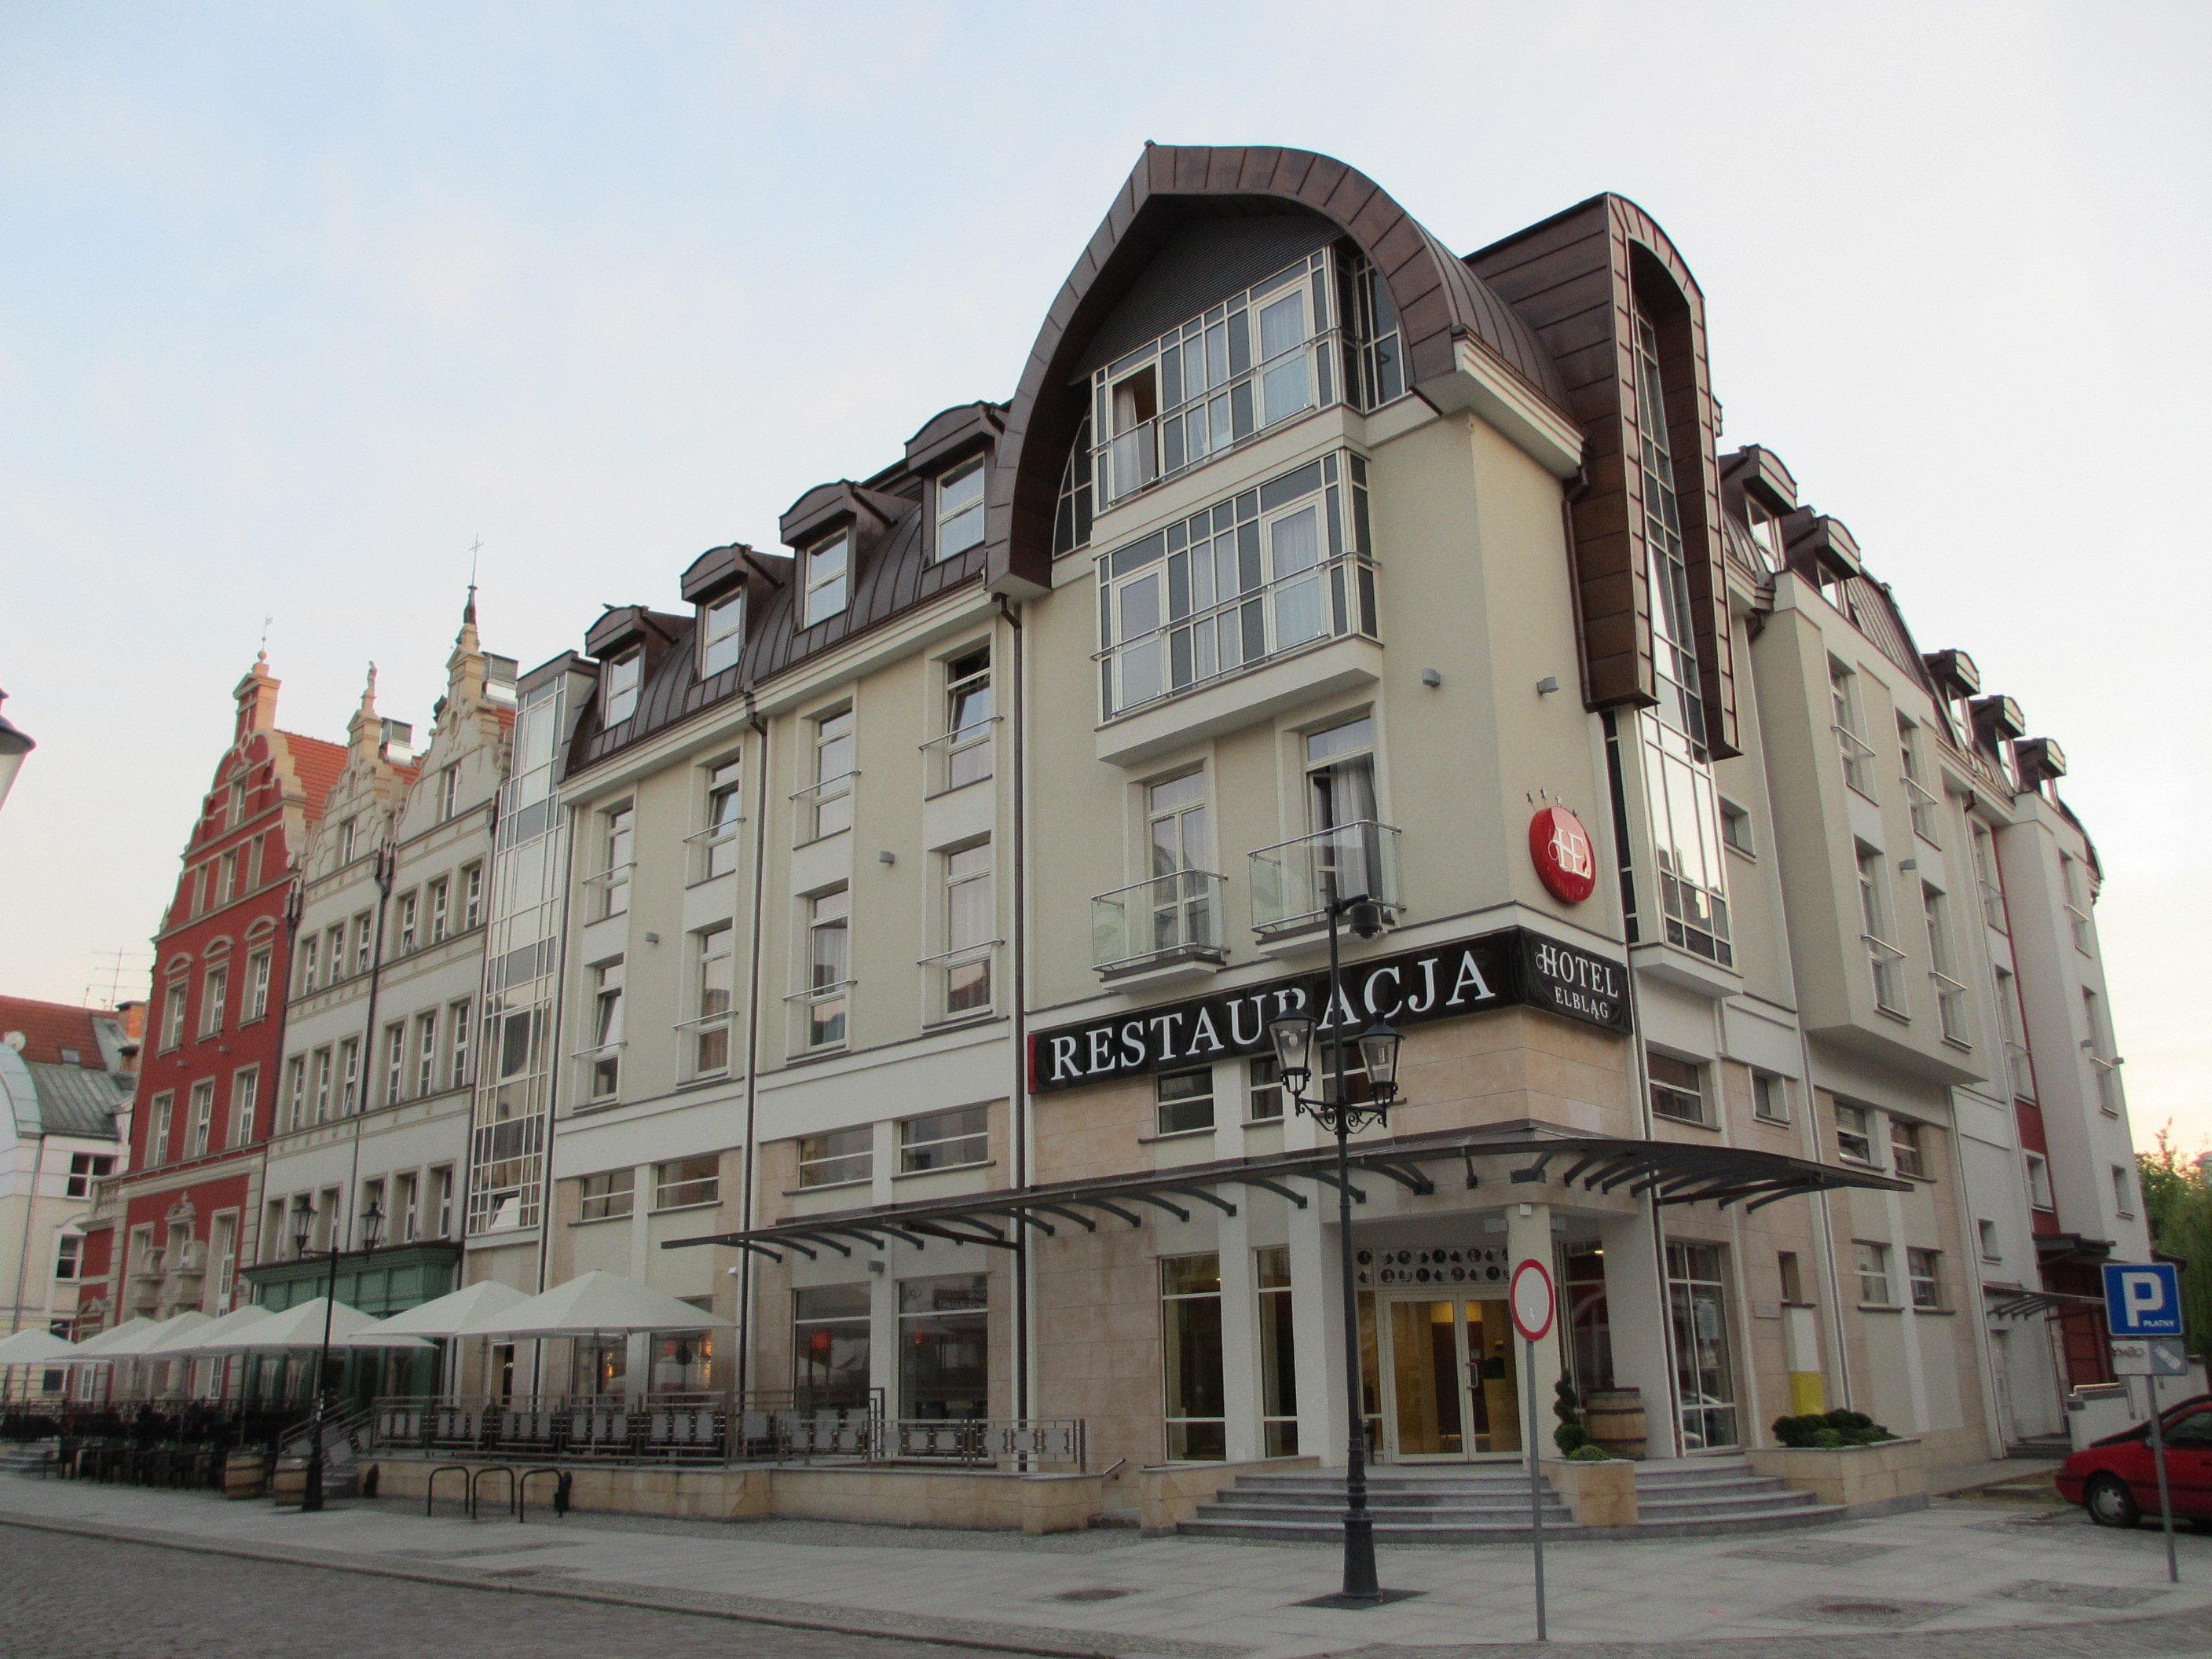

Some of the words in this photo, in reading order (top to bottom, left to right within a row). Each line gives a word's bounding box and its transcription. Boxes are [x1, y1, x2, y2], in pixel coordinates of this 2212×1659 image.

[1536, 944, 1618, 998] HOTEL
[1555, 987, 1609, 1019] ELBLĄG
[2122, 1272, 2163, 1327] P
